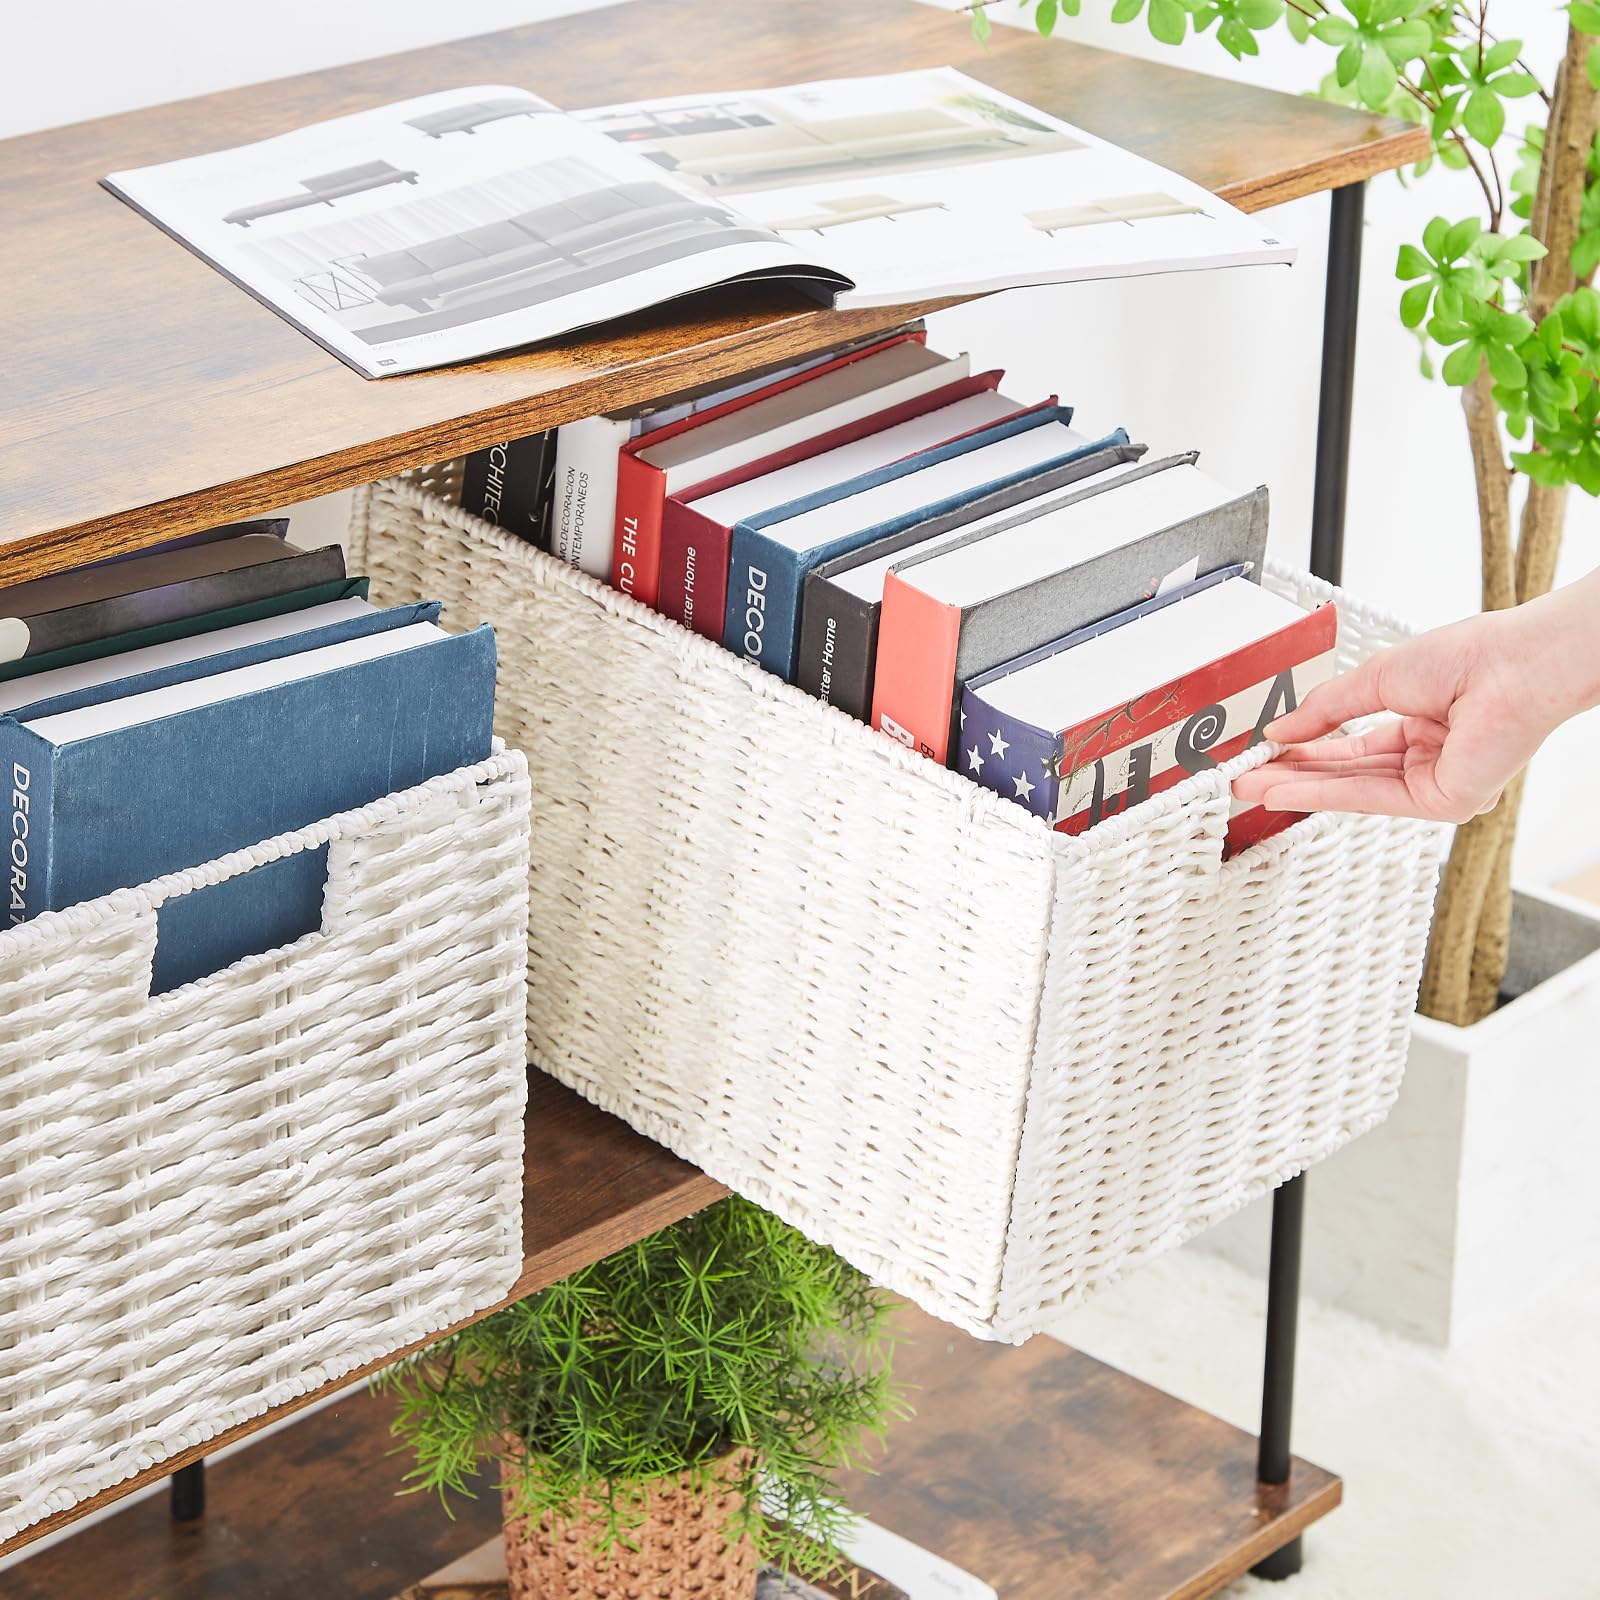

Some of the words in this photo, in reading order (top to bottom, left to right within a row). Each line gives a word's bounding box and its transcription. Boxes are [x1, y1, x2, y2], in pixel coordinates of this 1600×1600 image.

[622, 517, 638, 557] THE
[684, 546, 697, 594] Home
[823, 618, 837, 667] Home
